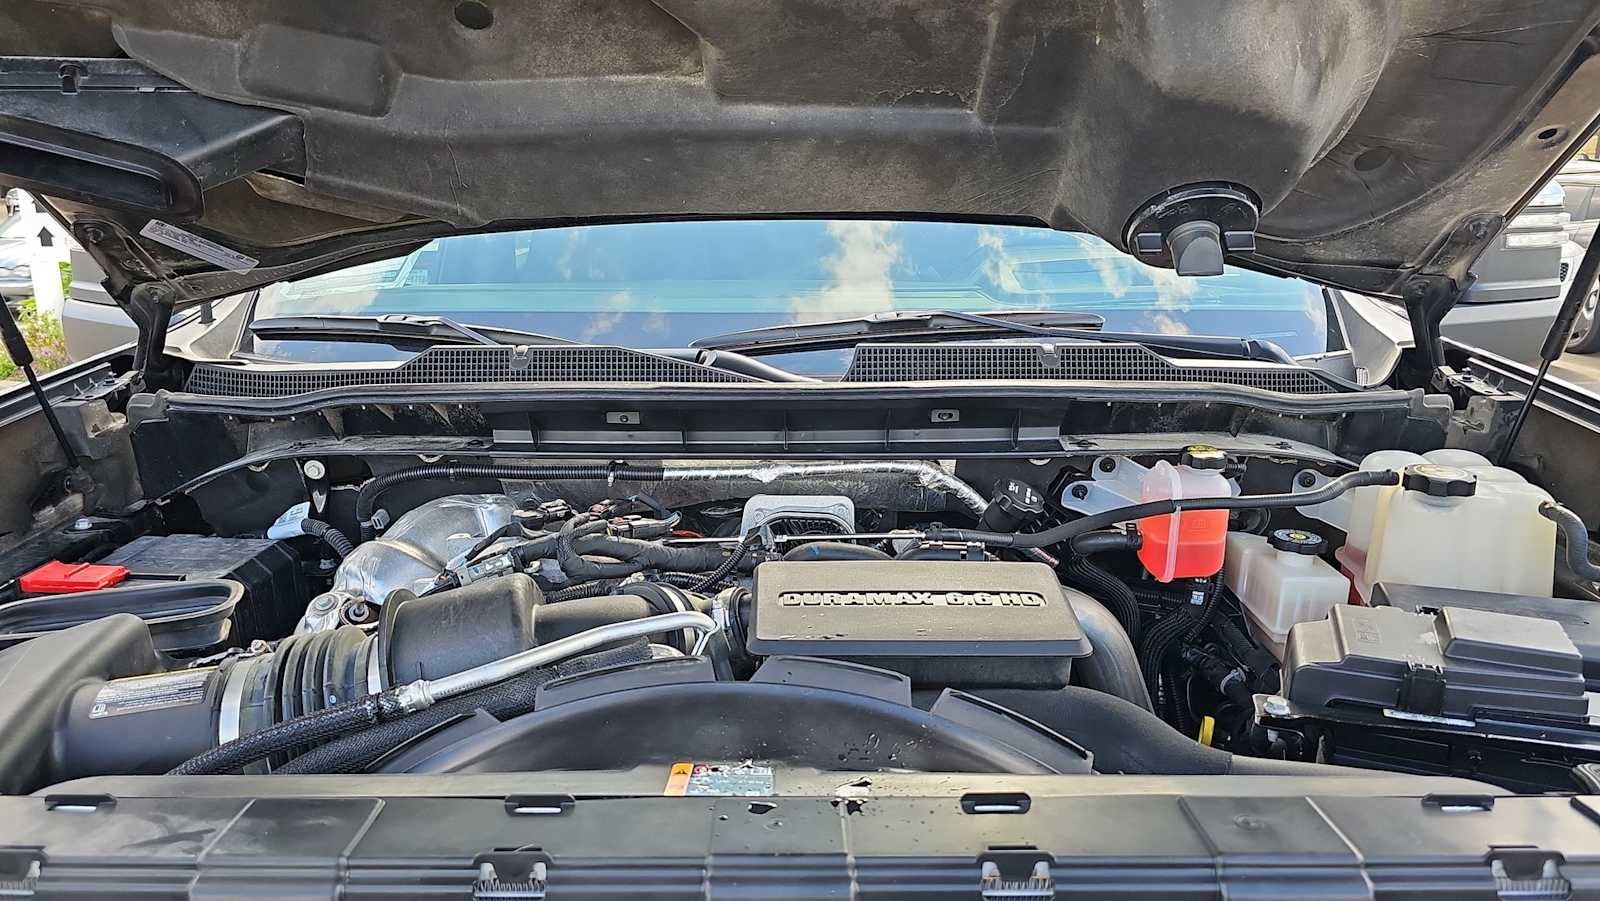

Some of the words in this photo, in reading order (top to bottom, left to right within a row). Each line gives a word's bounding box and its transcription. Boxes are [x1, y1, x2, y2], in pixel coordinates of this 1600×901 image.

[782, 592, 934, 606] DURAMAX
[945, 593, 993, 606] 6.6
[1000, 593, 1043, 607] HD
